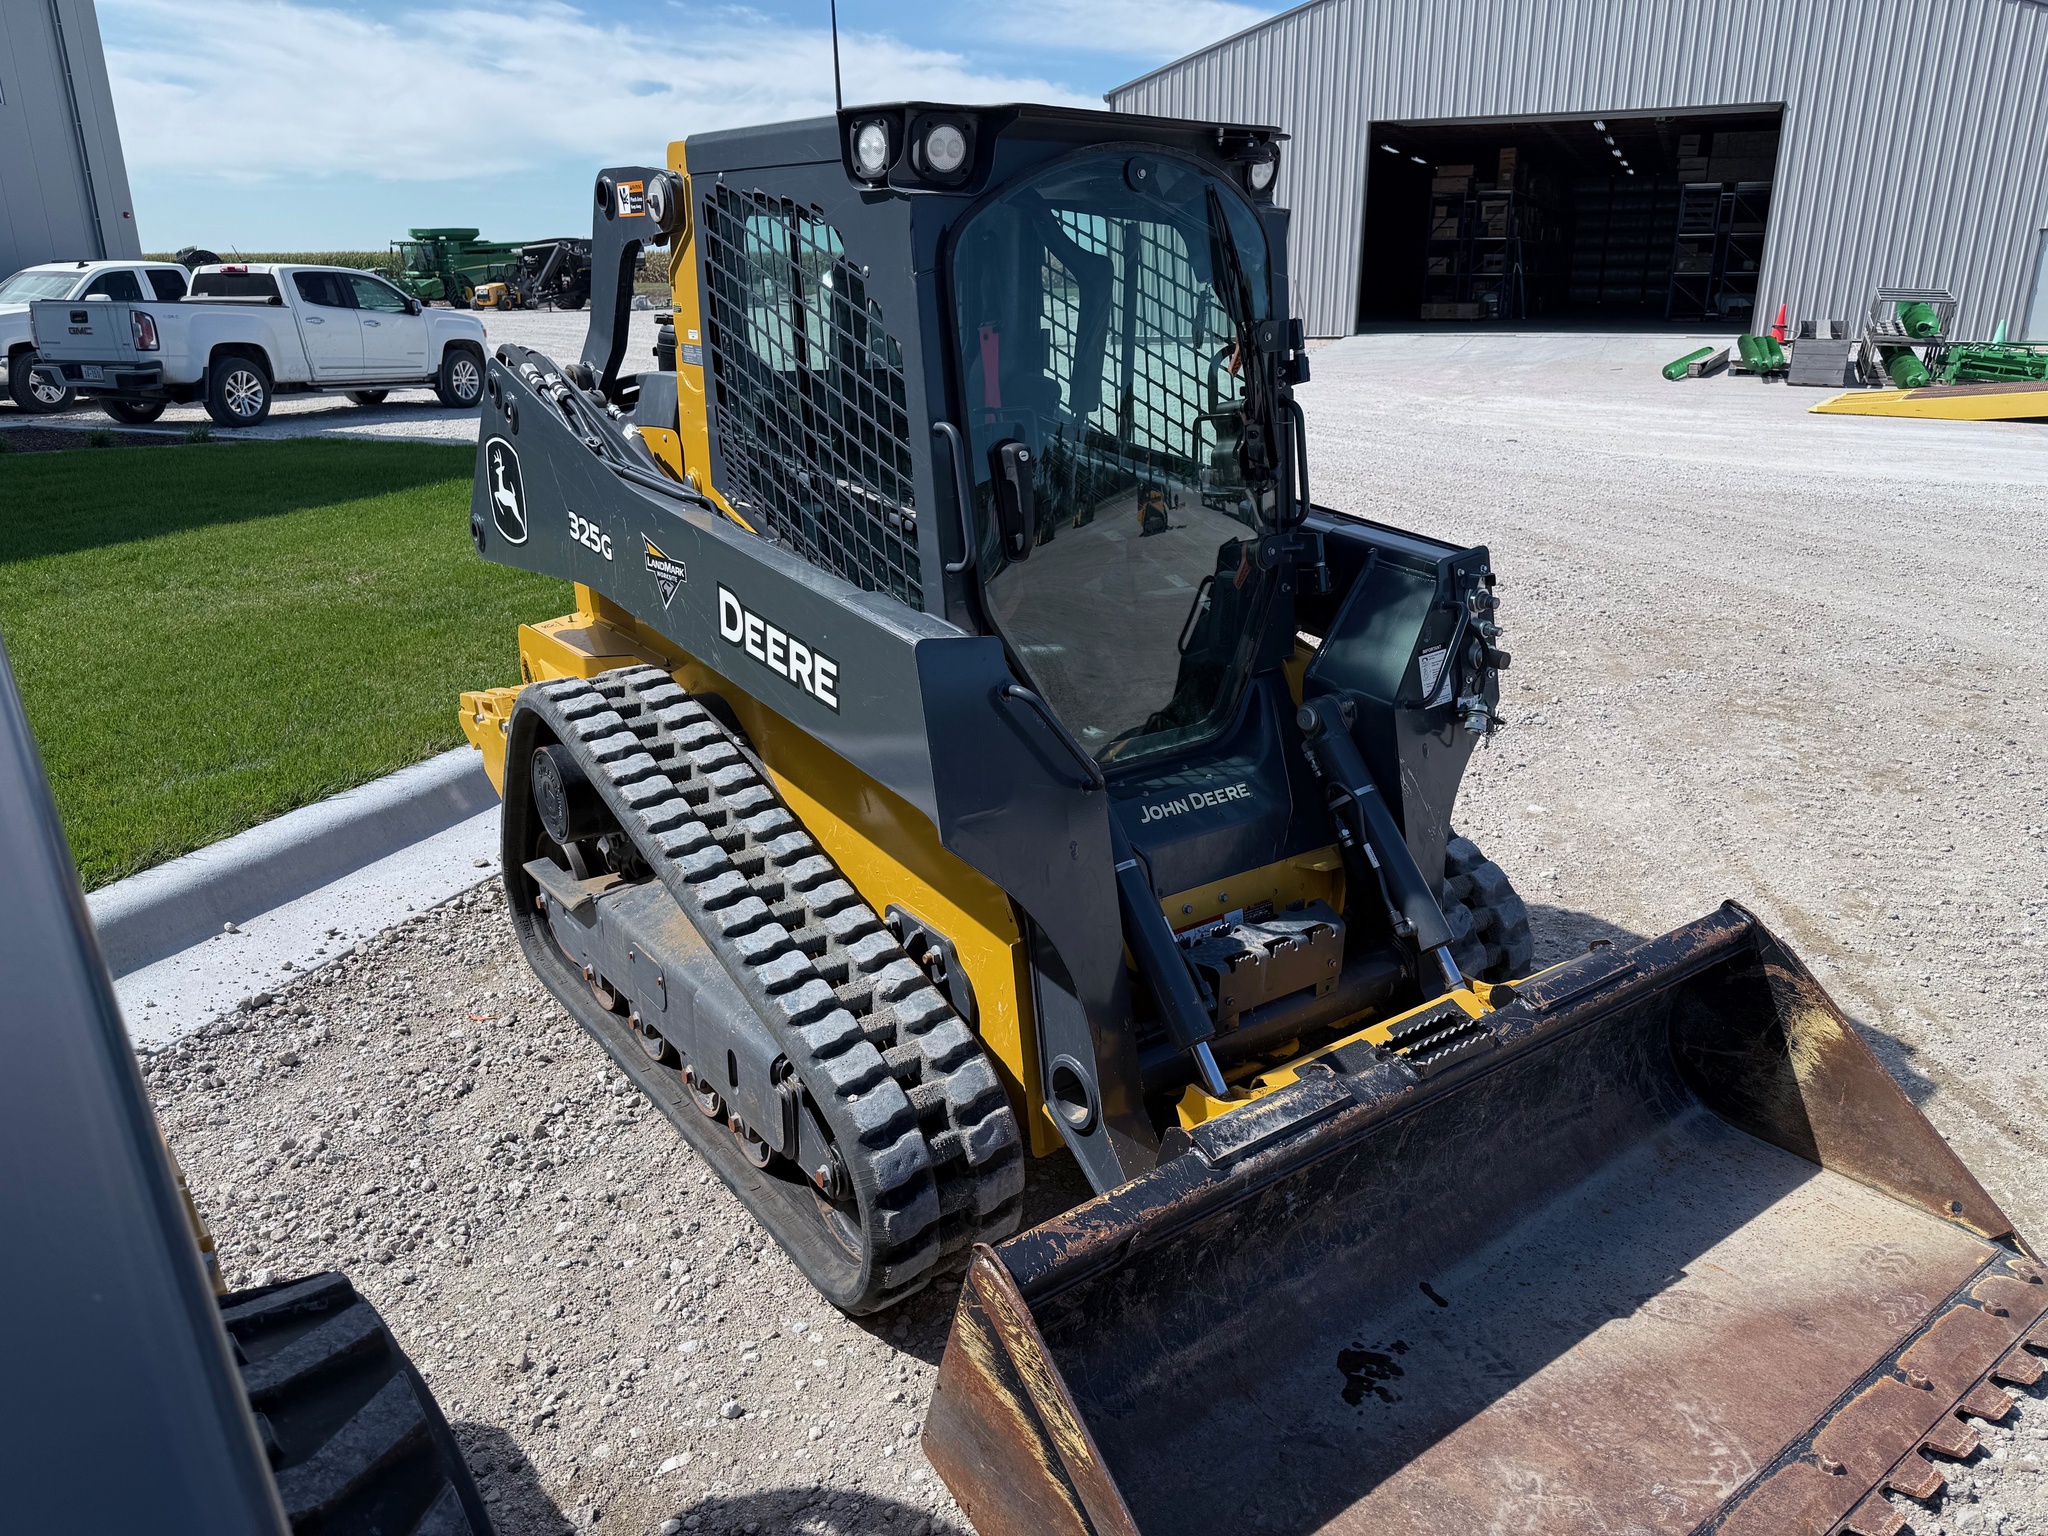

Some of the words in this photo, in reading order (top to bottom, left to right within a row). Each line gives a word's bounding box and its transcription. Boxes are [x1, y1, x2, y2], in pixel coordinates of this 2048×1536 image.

[68, 326, 93, 335] GMC
[568, 511, 613, 561] 325G
[647, 556, 685, 578] LANDMARK
[718, 586, 838, 709] DEERE
[1140, 798, 1190, 824] JOHN
[1188, 783, 1251, 811] DEERE
